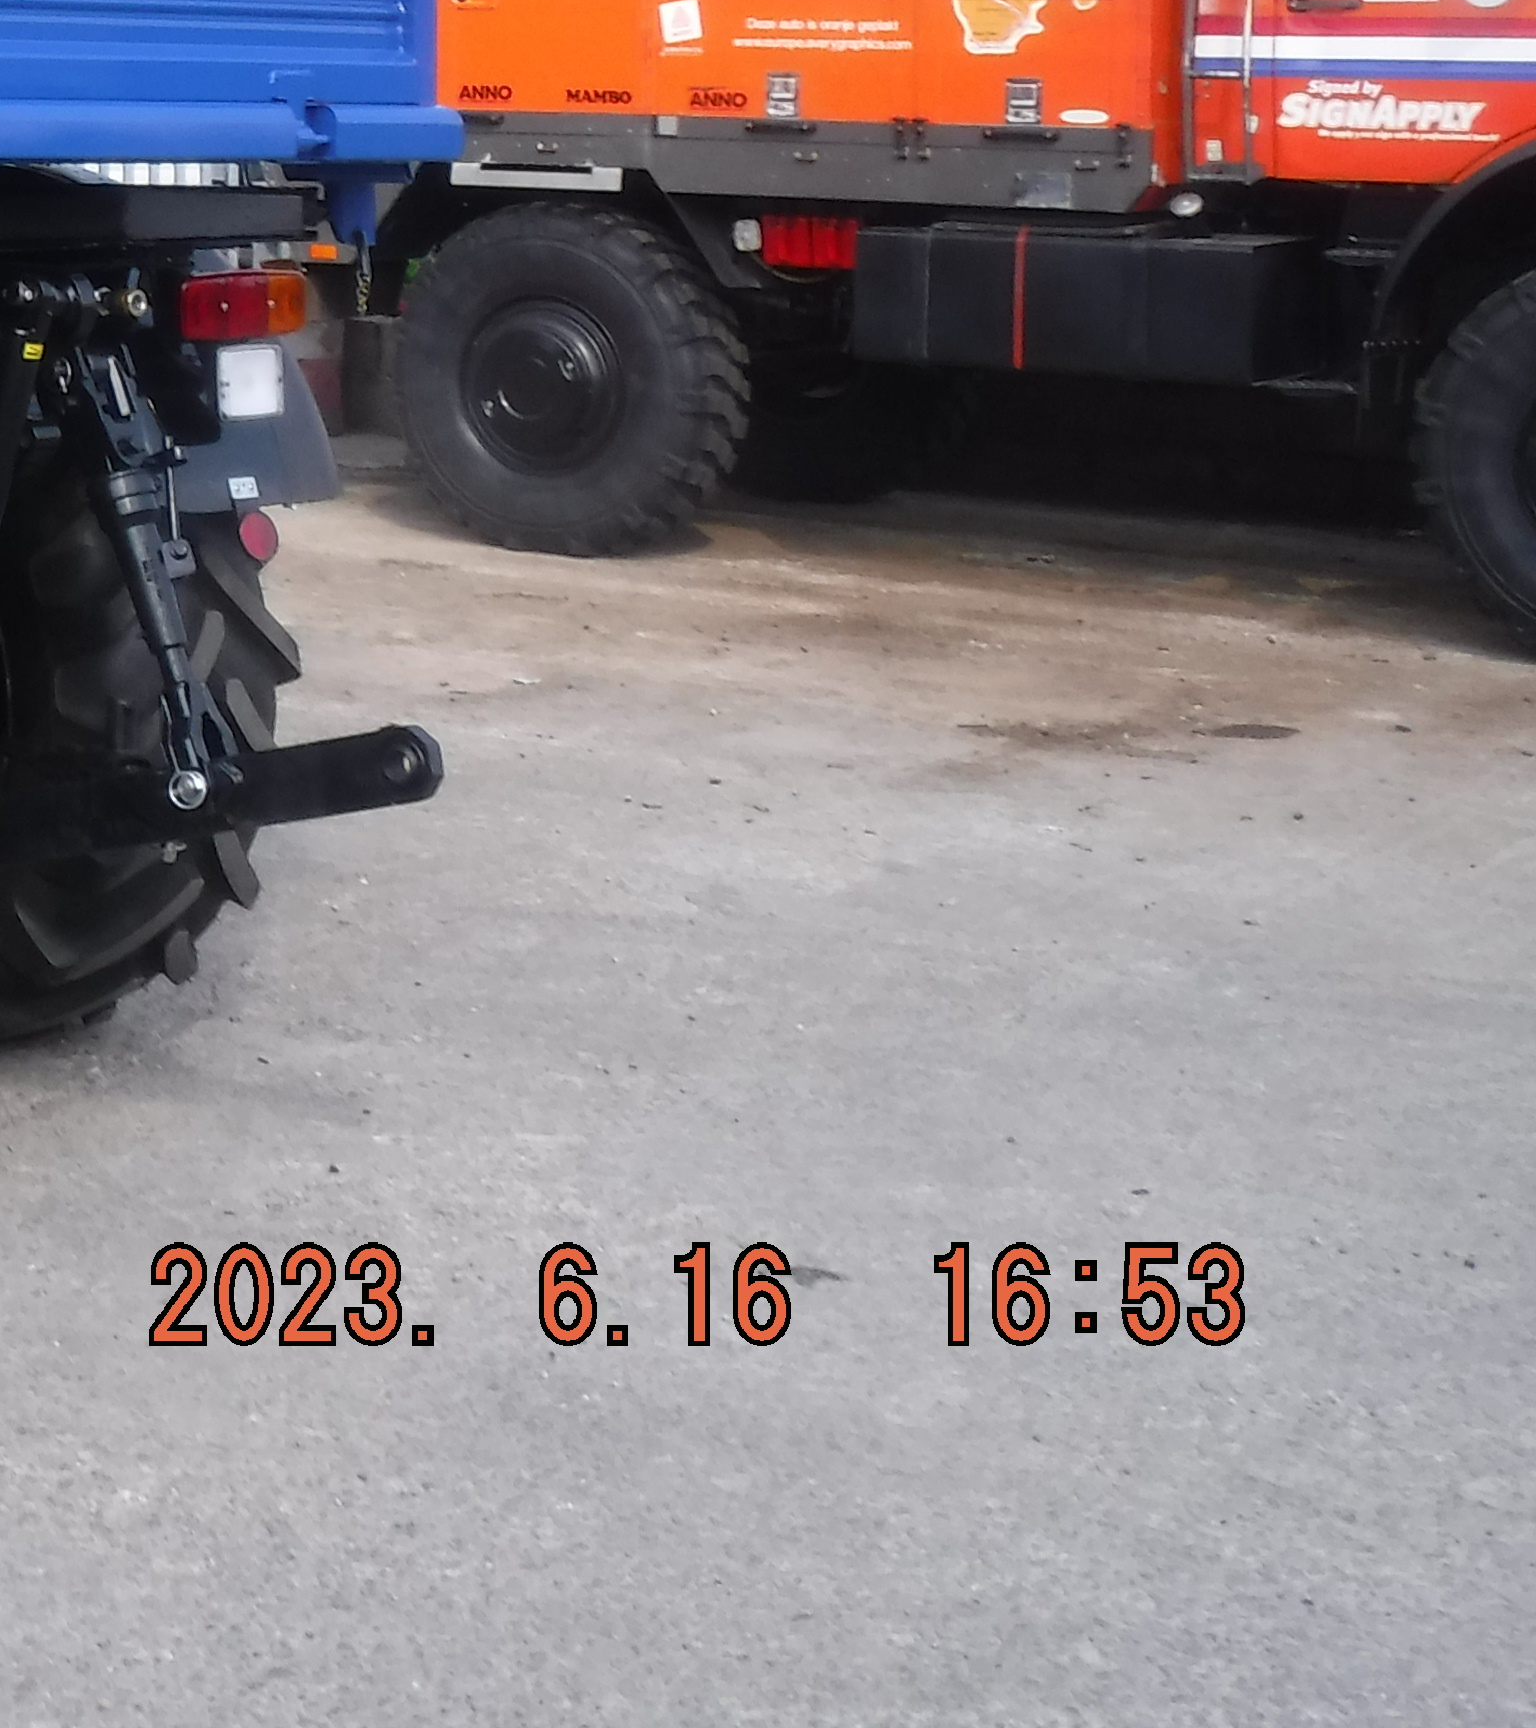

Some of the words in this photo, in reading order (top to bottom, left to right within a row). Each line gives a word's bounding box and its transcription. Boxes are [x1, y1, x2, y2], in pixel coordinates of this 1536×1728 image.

[459, 85, 513, 101] ANNO
[566, 88, 632, 104] MAMBO
[1307, 79, 1361, 97] Signed
[1362, 80, 1384, 98] by
[689, 91, 748, 108] ANNO
